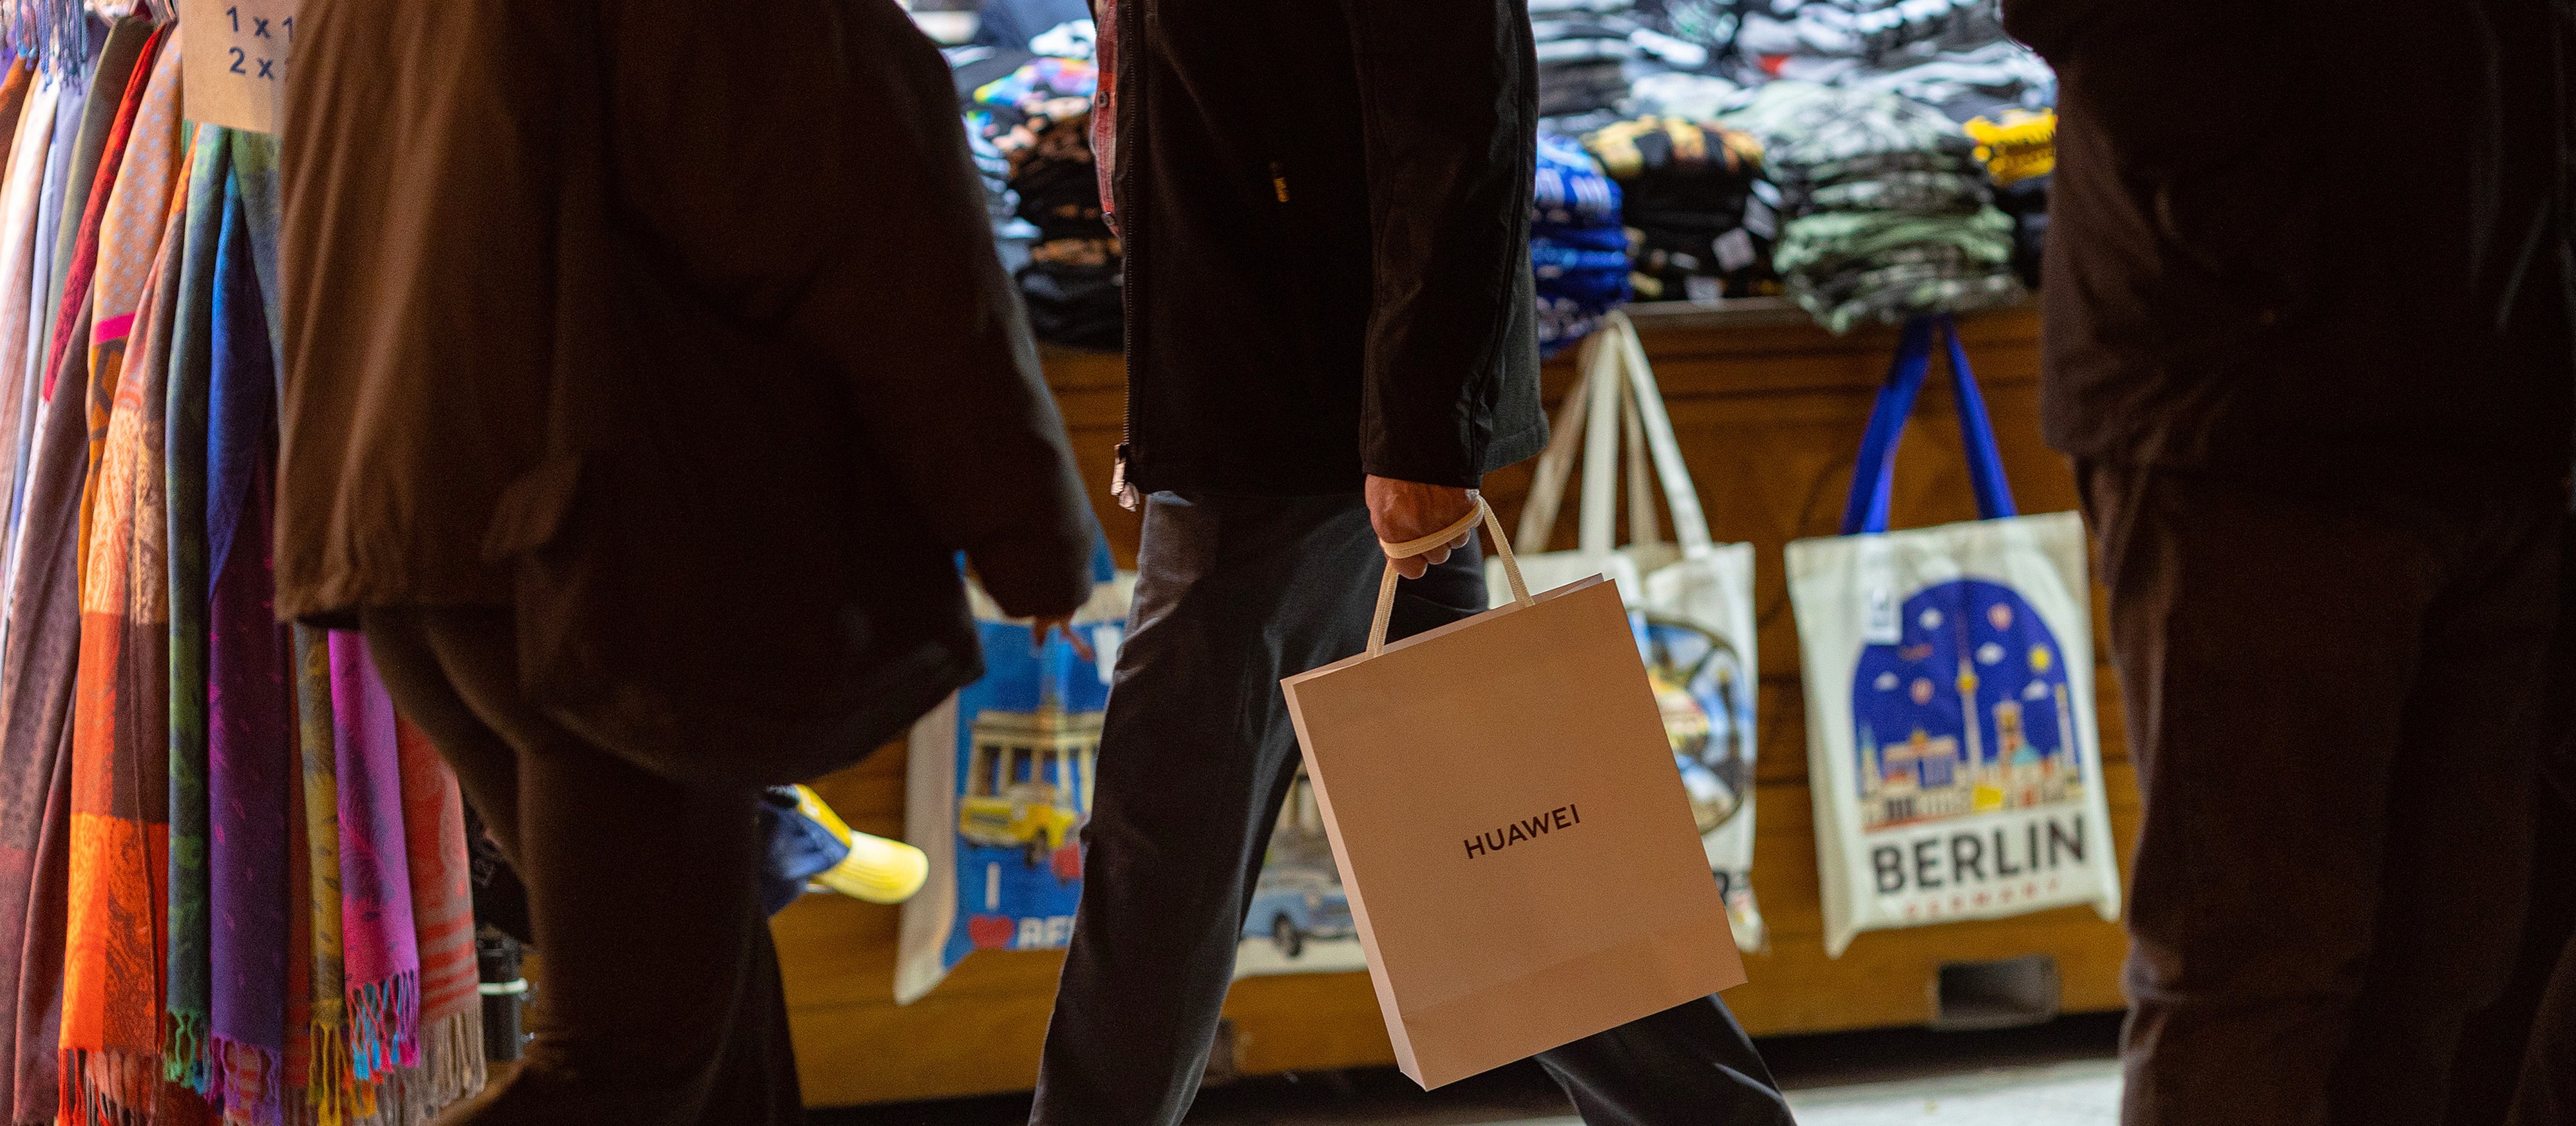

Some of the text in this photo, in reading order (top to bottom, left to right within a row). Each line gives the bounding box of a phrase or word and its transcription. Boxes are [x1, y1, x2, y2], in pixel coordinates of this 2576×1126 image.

[227, 6, 239, 33] 1
[253, 17, 270, 39] x
[229, 46, 275, 81] 2 x
[1464, 803, 1580, 859] HUAWEI
[1871, 813, 2085, 894] BERLIN
